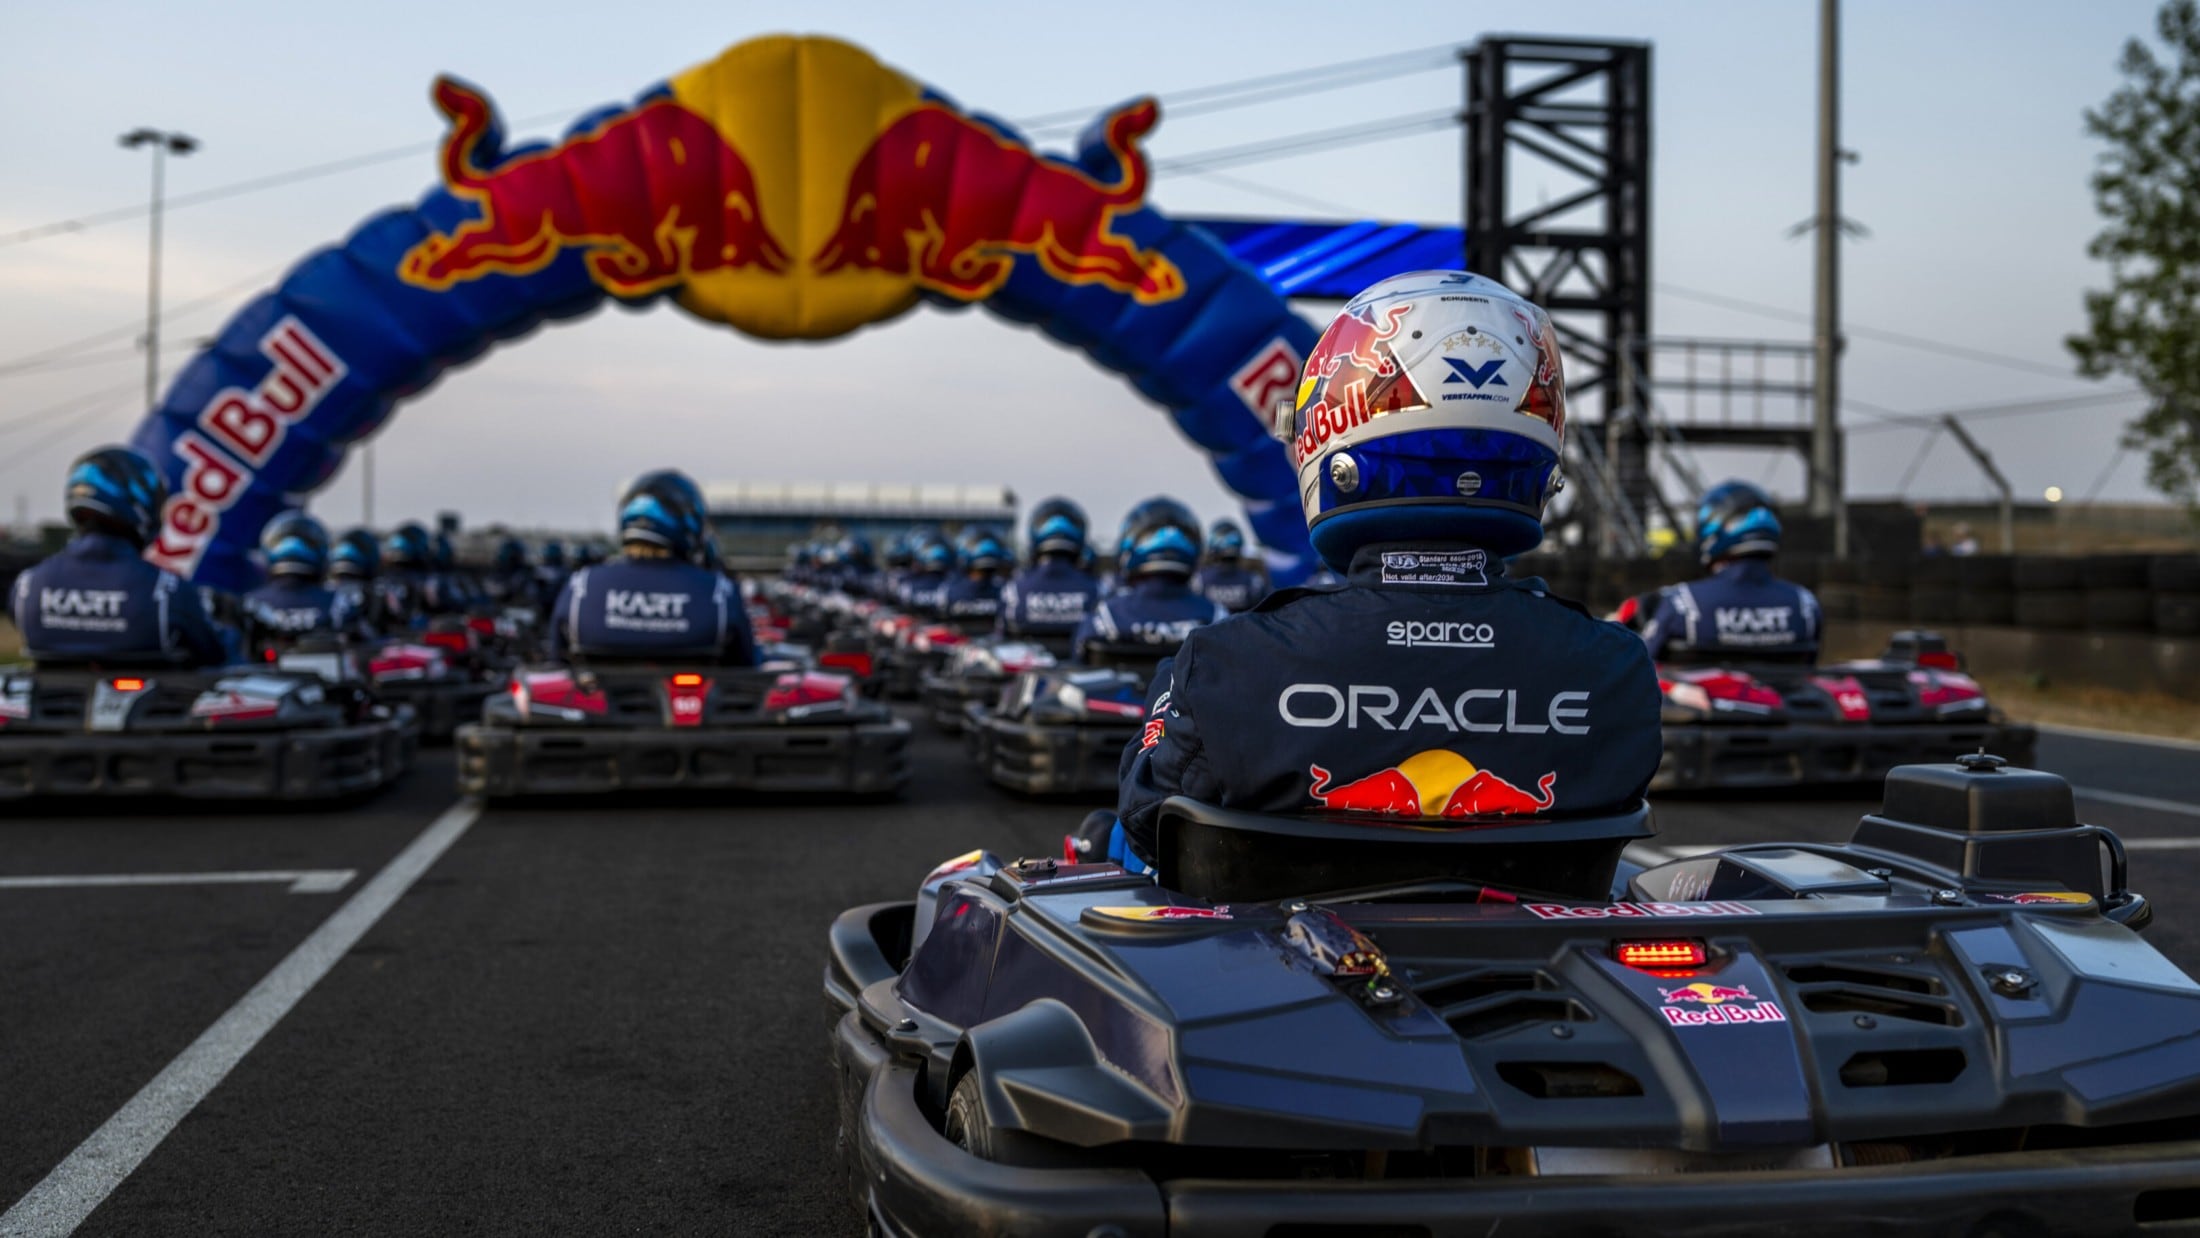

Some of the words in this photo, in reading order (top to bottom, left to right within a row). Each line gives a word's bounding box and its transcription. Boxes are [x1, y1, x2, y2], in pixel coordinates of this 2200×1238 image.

[1440, 295, 1489, 304] SCHUBERTH
[204, 320, 341, 463] Bull
[1442, 393, 1510, 403] VERSTAPPEN.COM
[1313, 378, 1369, 445] Bull
[1385, 573, 1398, 581] Not
[1401, 573, 1416, 581] valid
[40, 587, 128, 616] KART
[605, 589, 690, 616] KART
[1714, 606, 1794, 632] KART
[1387, 621, 1495, 647] sparco
[1278, 683, 1591, 735] ORACLE
[1522, 902, 1649, 919] Red
[1637, 901, 1762, 917] Bull
[1660, 1004, 1725, 1026] Red
[1721, 1001, 1786, 1024] Bull
